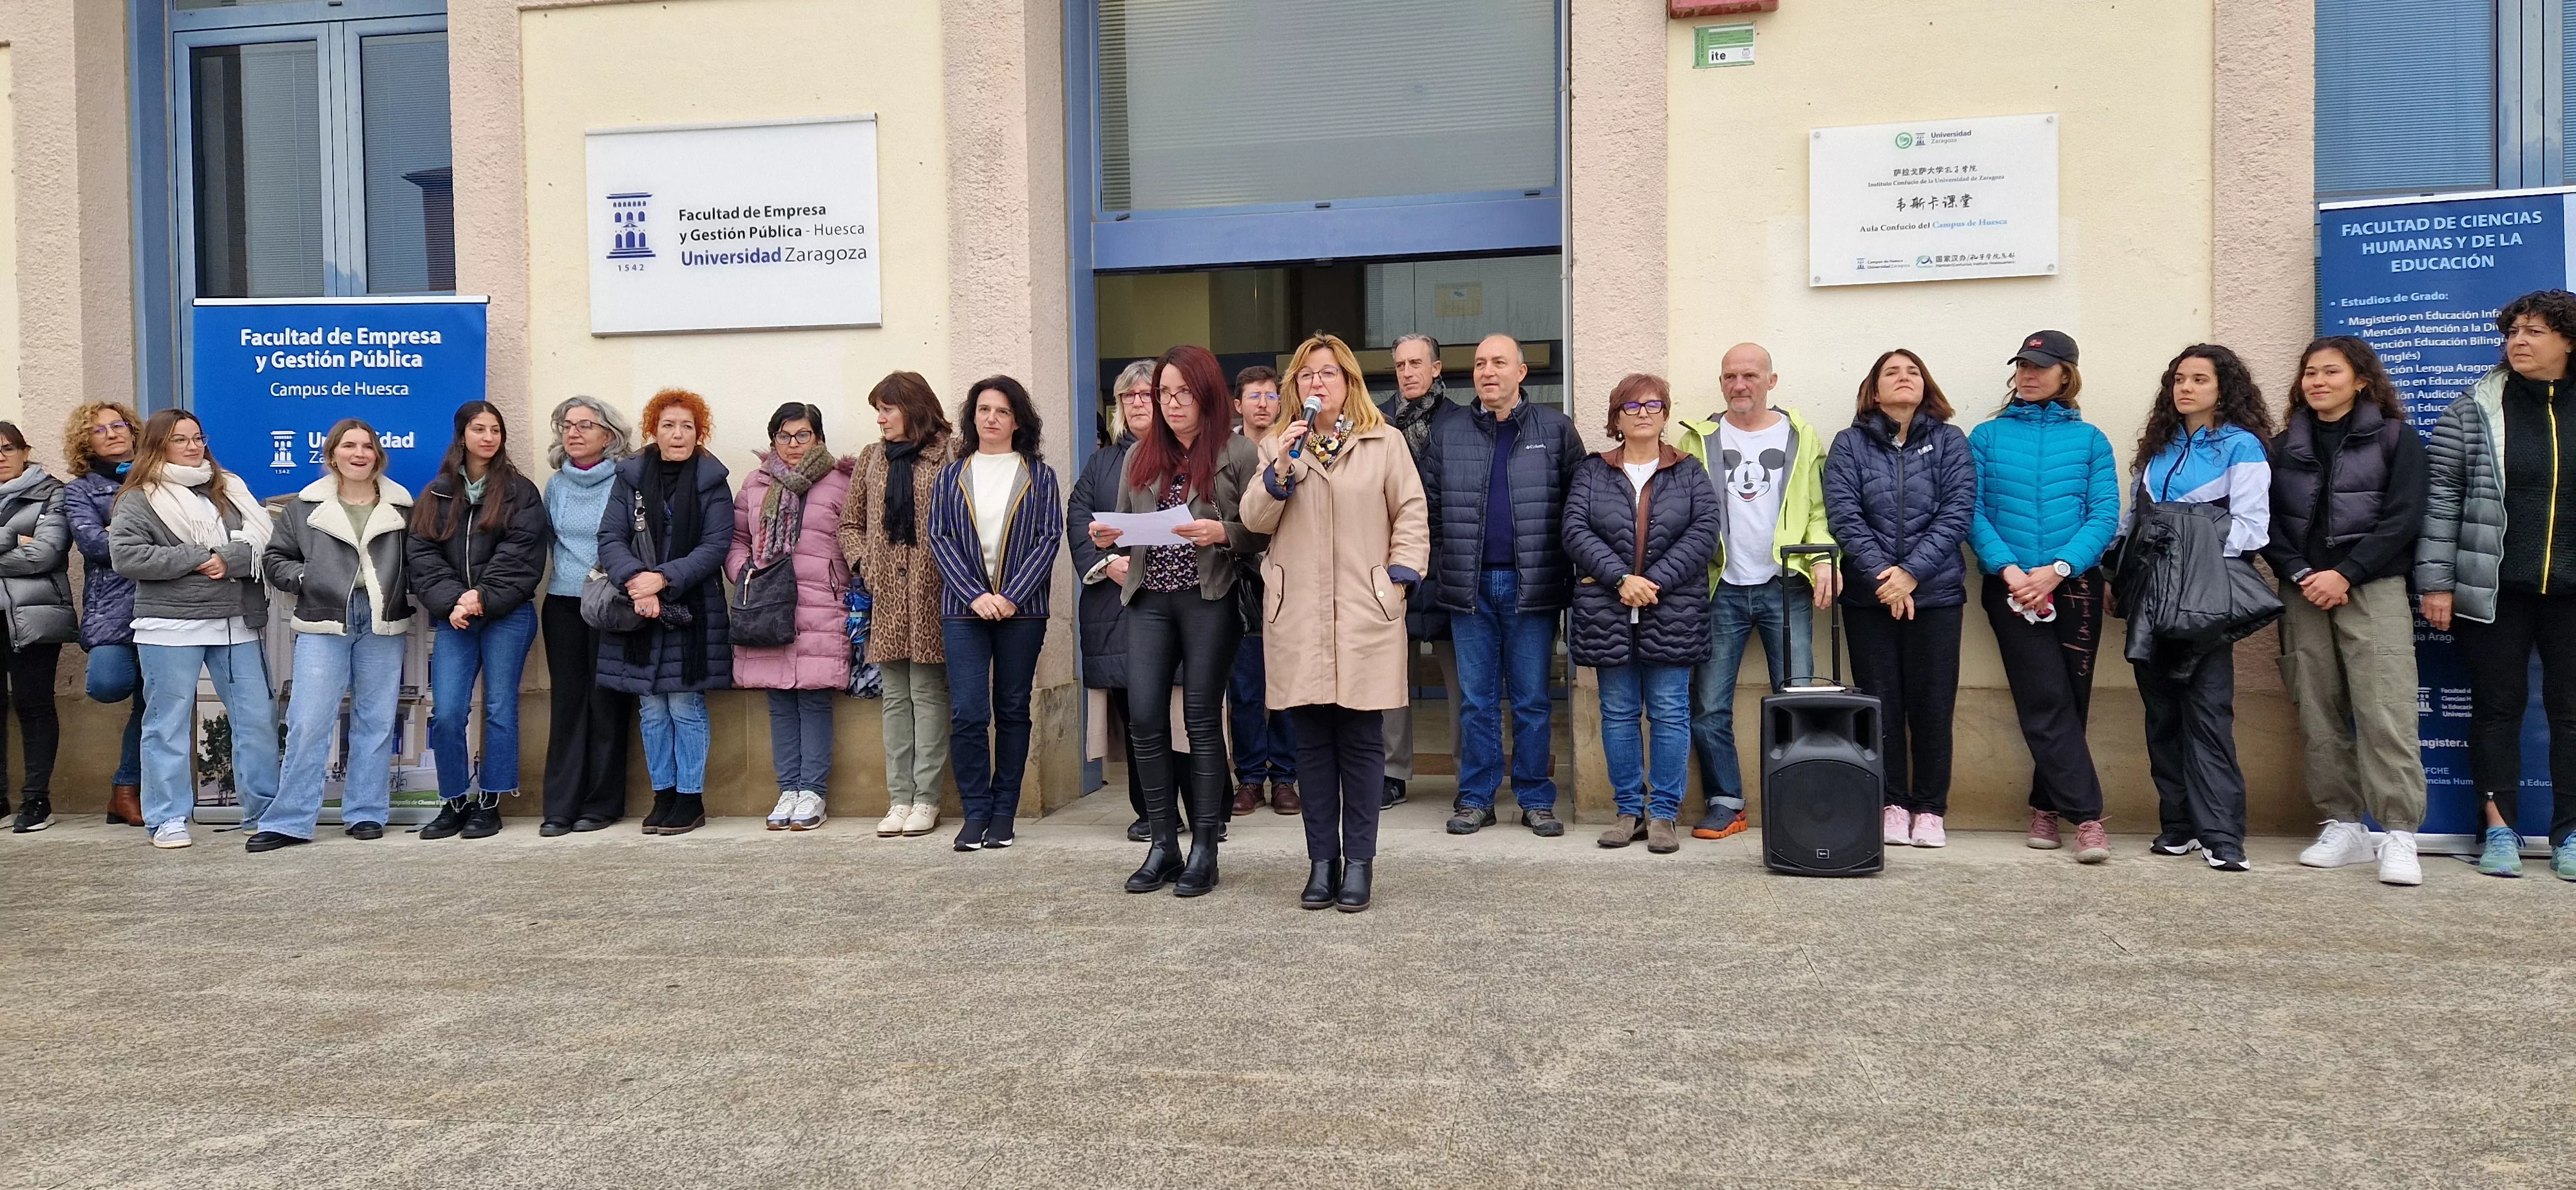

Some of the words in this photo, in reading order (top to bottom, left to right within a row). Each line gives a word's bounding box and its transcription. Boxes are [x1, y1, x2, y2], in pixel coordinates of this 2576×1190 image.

[1711, 51, 1726, 61] ite
[1931, 129, 1972, 138] Universidad
[1896, 193, 1973, 212] 韦斯卡课堂
[679, 207, 740, 222] Facultad
[743, 206, 761, 219] de
[764, 204, 826, 220] Empresa
[1932, 221, 1965, 229] Campus
[2342, 218, 2430, 236] FACULTAD
[2434, 216, 2456, 229] DE
[2461, 211, 2543, 228] CIENCIAS
[679, 232, 687, 245] y
[690, 227, 746, 241] Gestión
[750, 224, 802, 239] Pública
[814, 223, 865, 236] Huesca
[2362, 238, 2452, 255] HUMANAS
[2456, 236, 2468, 249] Y
[2472, 234, 2496, 248] DE
[2499, 232, 2523, 246] LA
[681, 247, 781, 266] Universidad
[784, 246, 867, 264] Zaragoza
[2391, 253, 2494, 273] EDUCACIÓN
[2341, 296, 2391, 307] Estudios
[2394, 294, 2408, 303] de
[2410, 291, 2449, 301] Grado:
[2349, 314, 2407, 327] Magisterio
[2426, 309, 2479, 320] Educación
[2481, 308, 2503, 318] Infa
[241, 327, 322, 346] Facultad
[327, 327, 353, 345] de
[357, 327, 442, 349] Empresa
[2363, 325, 2412, 338] Mención
[2414, 323, 2460, 334] Atención
[2471, 323, 2481, 332] la
[2414, 337, 2467, 347] Educación
[256, 355, 268, 373] y
[271, 350, 345, 369] Gestión
[350, 348, 423, 369] Pública
[2380, 351, 2421, 363] (Inglés)
[2383, 365, 2413, 375] nción
[2416, 364, 2454, 375] Lengua
[270, 382, 328, 399] Campus
[332, 381, 350, 396] de
[355, 381, 409, 396] Huesca
[2418, 417, 2437, 426] Len
